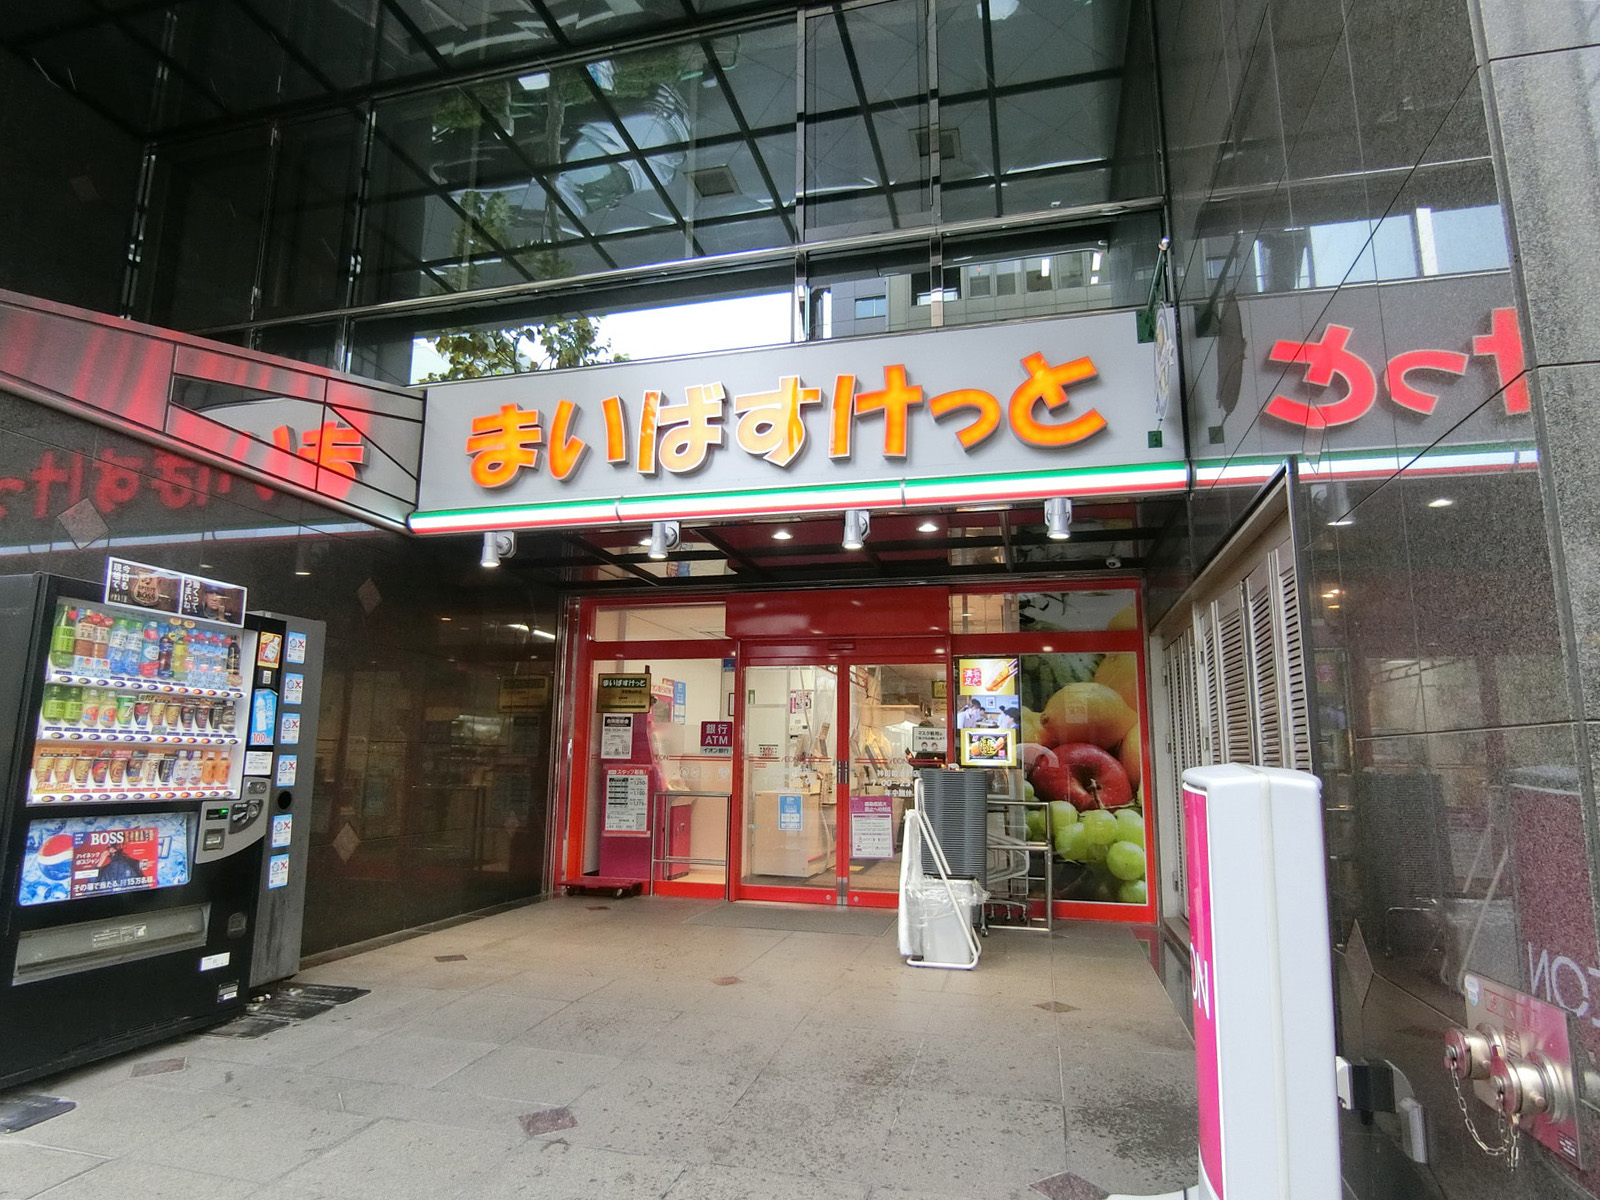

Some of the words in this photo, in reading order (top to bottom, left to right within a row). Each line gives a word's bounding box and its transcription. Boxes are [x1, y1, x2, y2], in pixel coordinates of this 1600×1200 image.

[465, 352, 1108, 490] まいばすけっと
[705, 724, 728, 734] 銀行
[705, 735, 728, 745] ATM
[90, 831, 124, 846] BOSS
